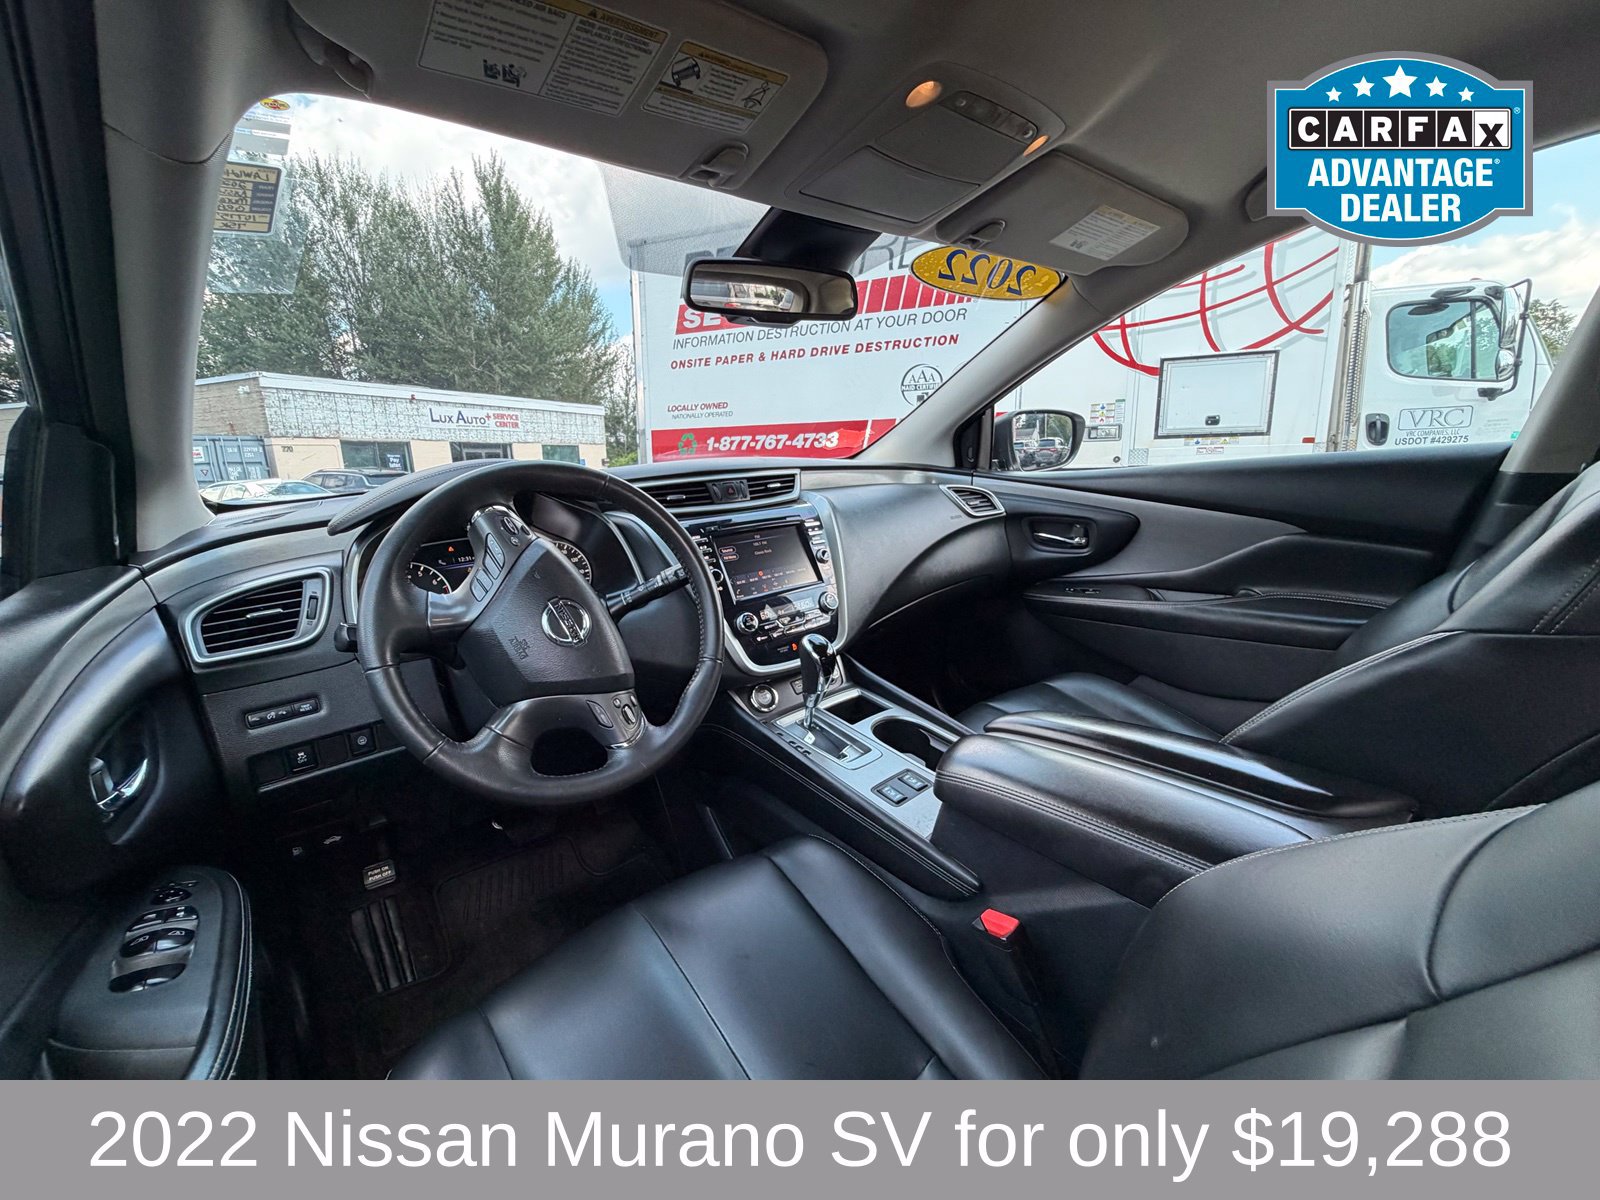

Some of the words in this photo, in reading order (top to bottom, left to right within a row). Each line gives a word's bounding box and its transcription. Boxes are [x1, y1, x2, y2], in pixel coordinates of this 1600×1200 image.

[672, 330, 754, 350] INFORMATION
[757, 320, 851, 341] DESTRUCTION
[854, 317, 873, 332] AT
[876, 313, 918, 329] YOUR
[922, 307, 968, 325] DOOR
[670, 357, 712, 370] ONSITE
[715, 353, 754, 366] PAPER
[758, 351, 766, 362] &
[770, 348, 806, 361] HARD
[810, 344, 851, 357] DRIVE
[855, 333, 960, 354] DESTRUCTION
[908, 369, 936, 384] AAA
[667, 403, 699, 412] LOCALLY
[700, 401, 729, 411] OWNED
[493, 412, 519, 421] SERVICE
[671, 412, 703, 420] NATIONALLY
[704, 410, 734, 419] OPERATED
[1407, 408, 1465, 428] VRC
[495, 420, 520, 429] CENTER
[706, 431, 839, 451] 1-877-767-4733
[1394, 436, 1428, 446] USDOT
[1430, 435, 1469, 444] #429275
[553, 602, 582, 644] NISSAN
[367, 868, 381, 876] PUSH
